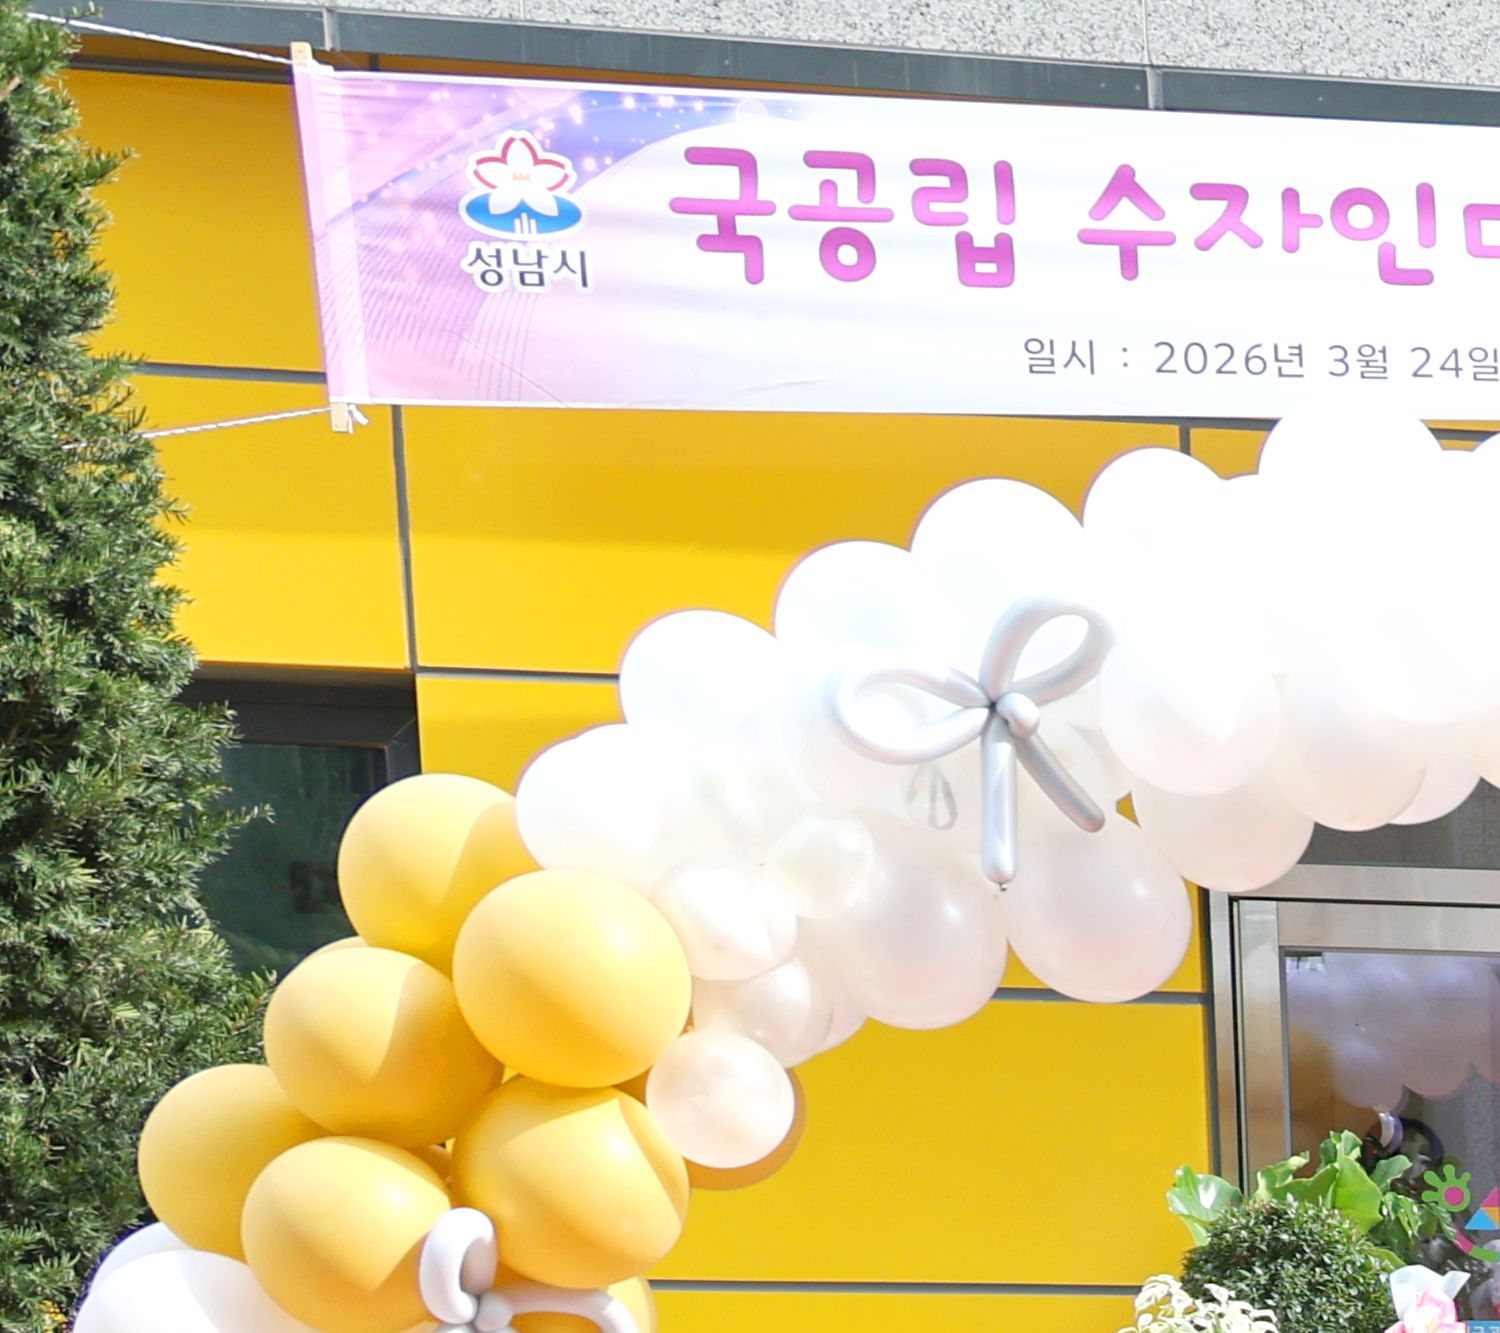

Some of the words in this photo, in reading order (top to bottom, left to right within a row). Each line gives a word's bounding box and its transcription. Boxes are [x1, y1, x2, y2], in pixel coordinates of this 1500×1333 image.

[670, 146, 1015, 288] 국공립
[468, 246, 590, 290] 성남시
[1023, 337, 1095, 376] 일시
[1154, 341, 1305, 379] 2026년
[1328, 343, 1390, 380] 3월
